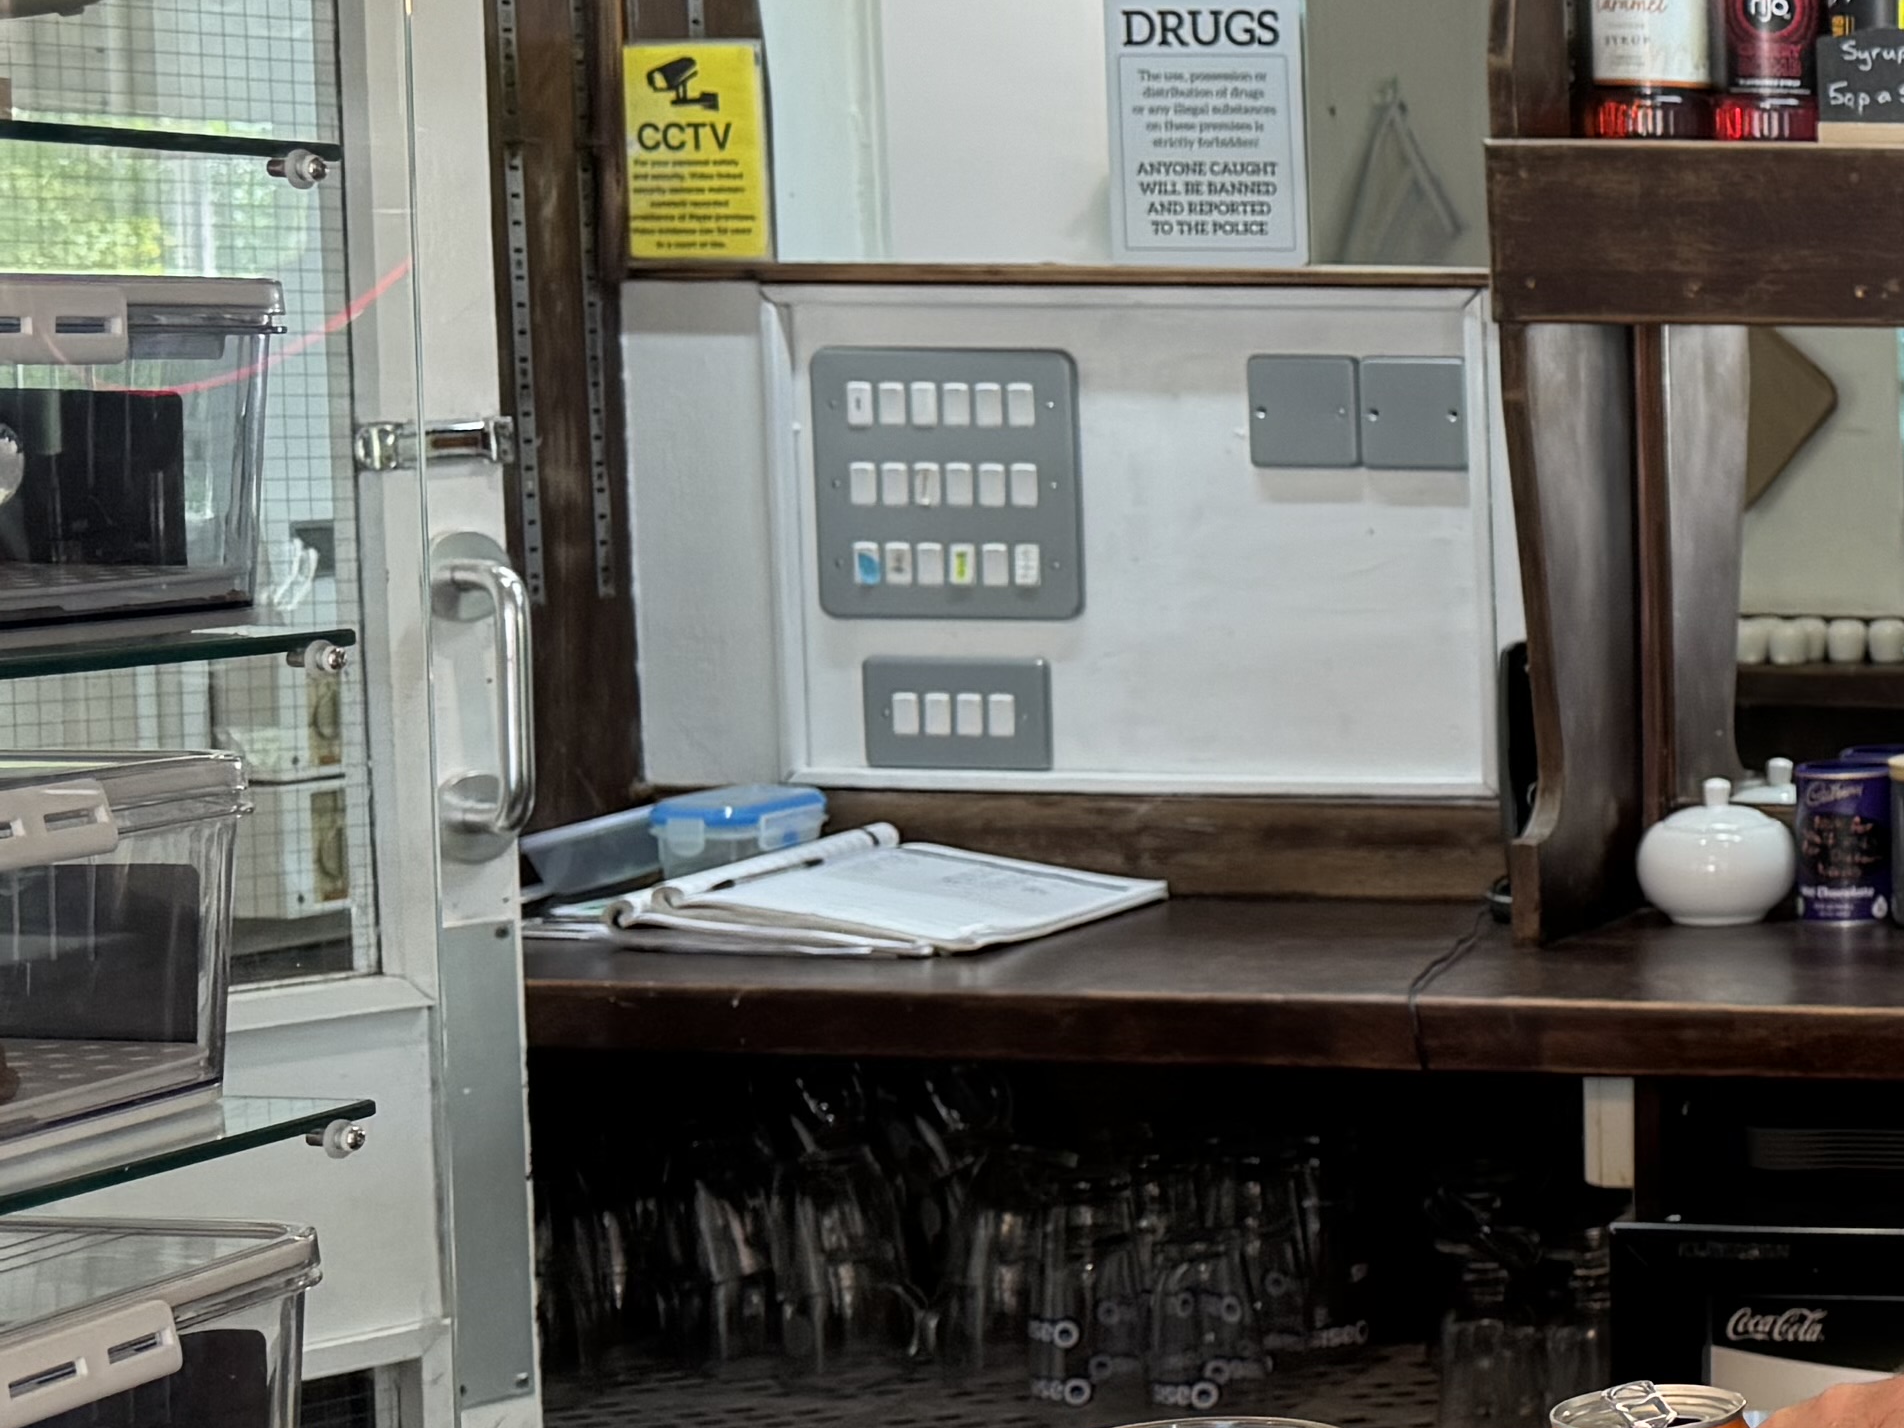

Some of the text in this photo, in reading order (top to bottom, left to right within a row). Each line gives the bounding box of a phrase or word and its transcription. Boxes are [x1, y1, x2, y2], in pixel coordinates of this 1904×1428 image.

[1121, 9, 1280, 47] DRUGS
[1878, 88, 1892, 103] a
[637, 122, 732, 151] CCTV
[1136, 160, 1278, 176] ANYONE CAUGHT
[1139, 180, 1278, 196] WILL BE BANNED
[1147, 200, 1272, 216] AND REPORTED
[1151, 220, 1269, 236] TO THE POLICE
[1806, 780, 1864, 808] Cadbury
[1726, 1306, 1828, 1342] Coca-Cola
